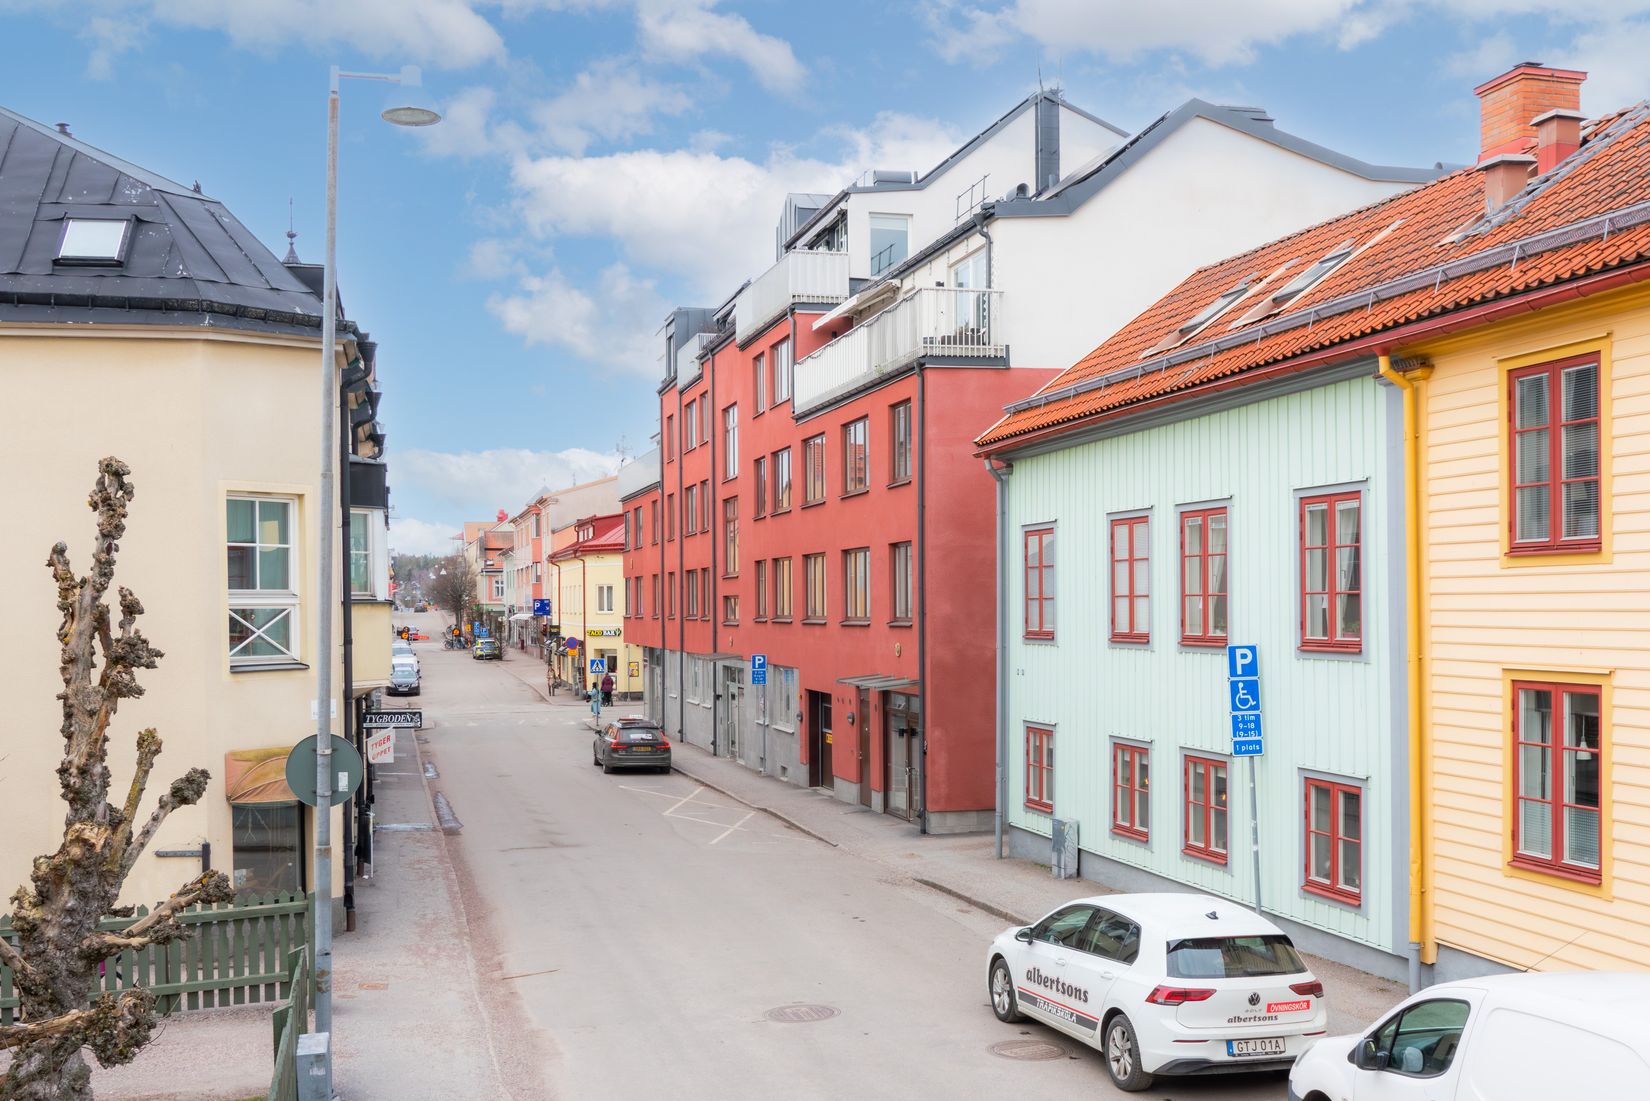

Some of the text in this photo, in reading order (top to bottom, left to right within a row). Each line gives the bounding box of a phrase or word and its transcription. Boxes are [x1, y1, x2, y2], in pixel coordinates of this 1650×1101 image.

[755, 656, 764, 668] P
[1235, 648, 1253, 675] P
[365, 714, 412, 723] TYGBODEN
[1236, 730, 1258, 738] (9-15)
[371, 735, 391, 749] TYGER
[1241, 744, 1260, 752] plats
[1026, 967, 1089, 1003] albertsons
[1036, 998, 1077, 1023] TRAFIKSKOLA
[1270, 1001, 1308, 1012] ÖVNINGSKÖR
[1227, 1015, 1279, 1024] albertsons
[1237, 1041, 1257, 1053] GTJ
